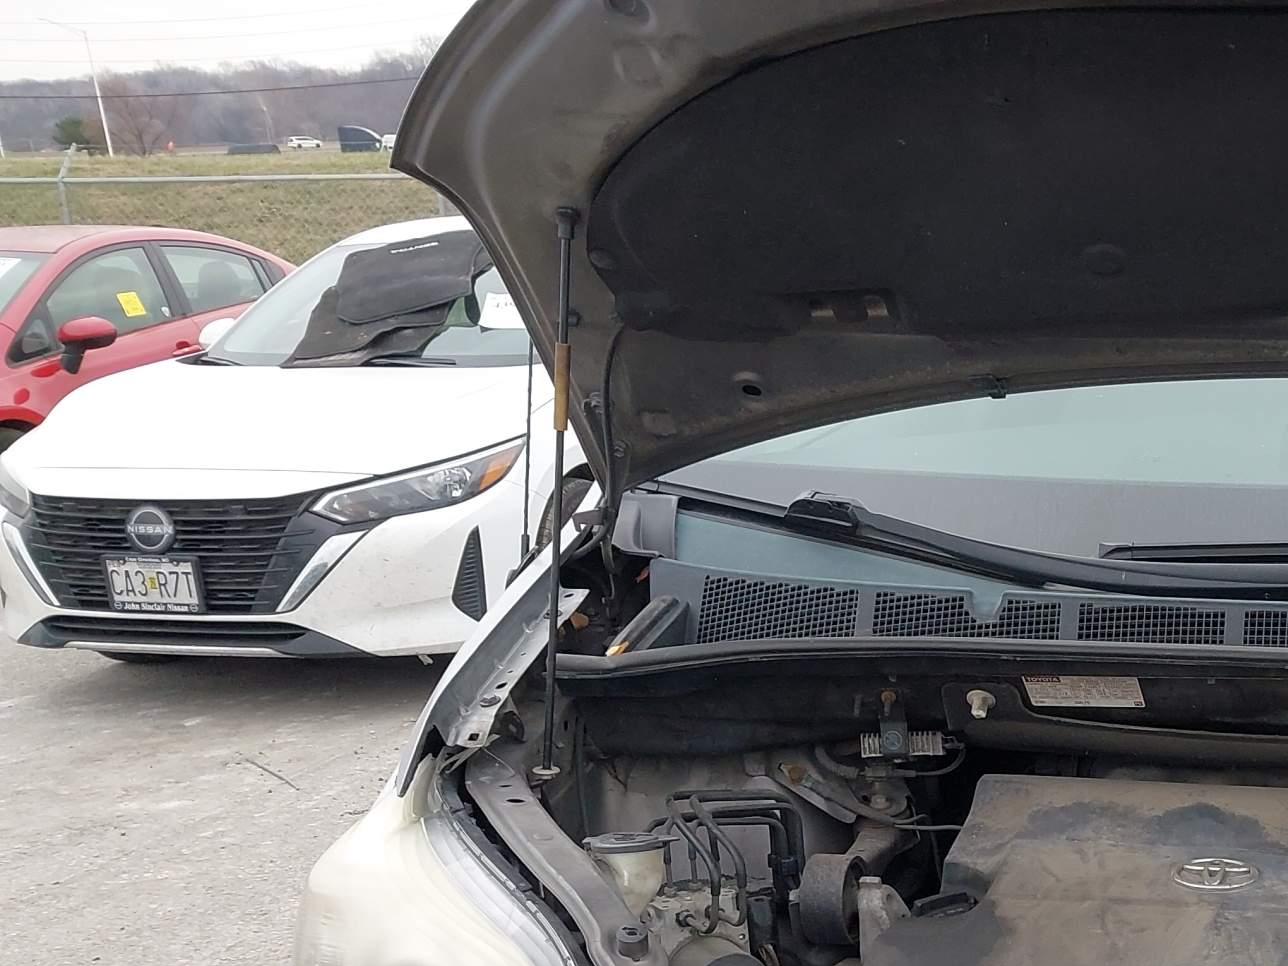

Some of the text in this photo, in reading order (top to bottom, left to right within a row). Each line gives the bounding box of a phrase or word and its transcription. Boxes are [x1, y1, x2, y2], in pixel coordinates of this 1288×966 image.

[127, 525, 174, 534] NISSAN
[110, 569, 148, 597] CA3
[155, 571, 192, 598] R7T
[124, 602, 140, 611] John
[167, 603, 189, 612] Nissan
